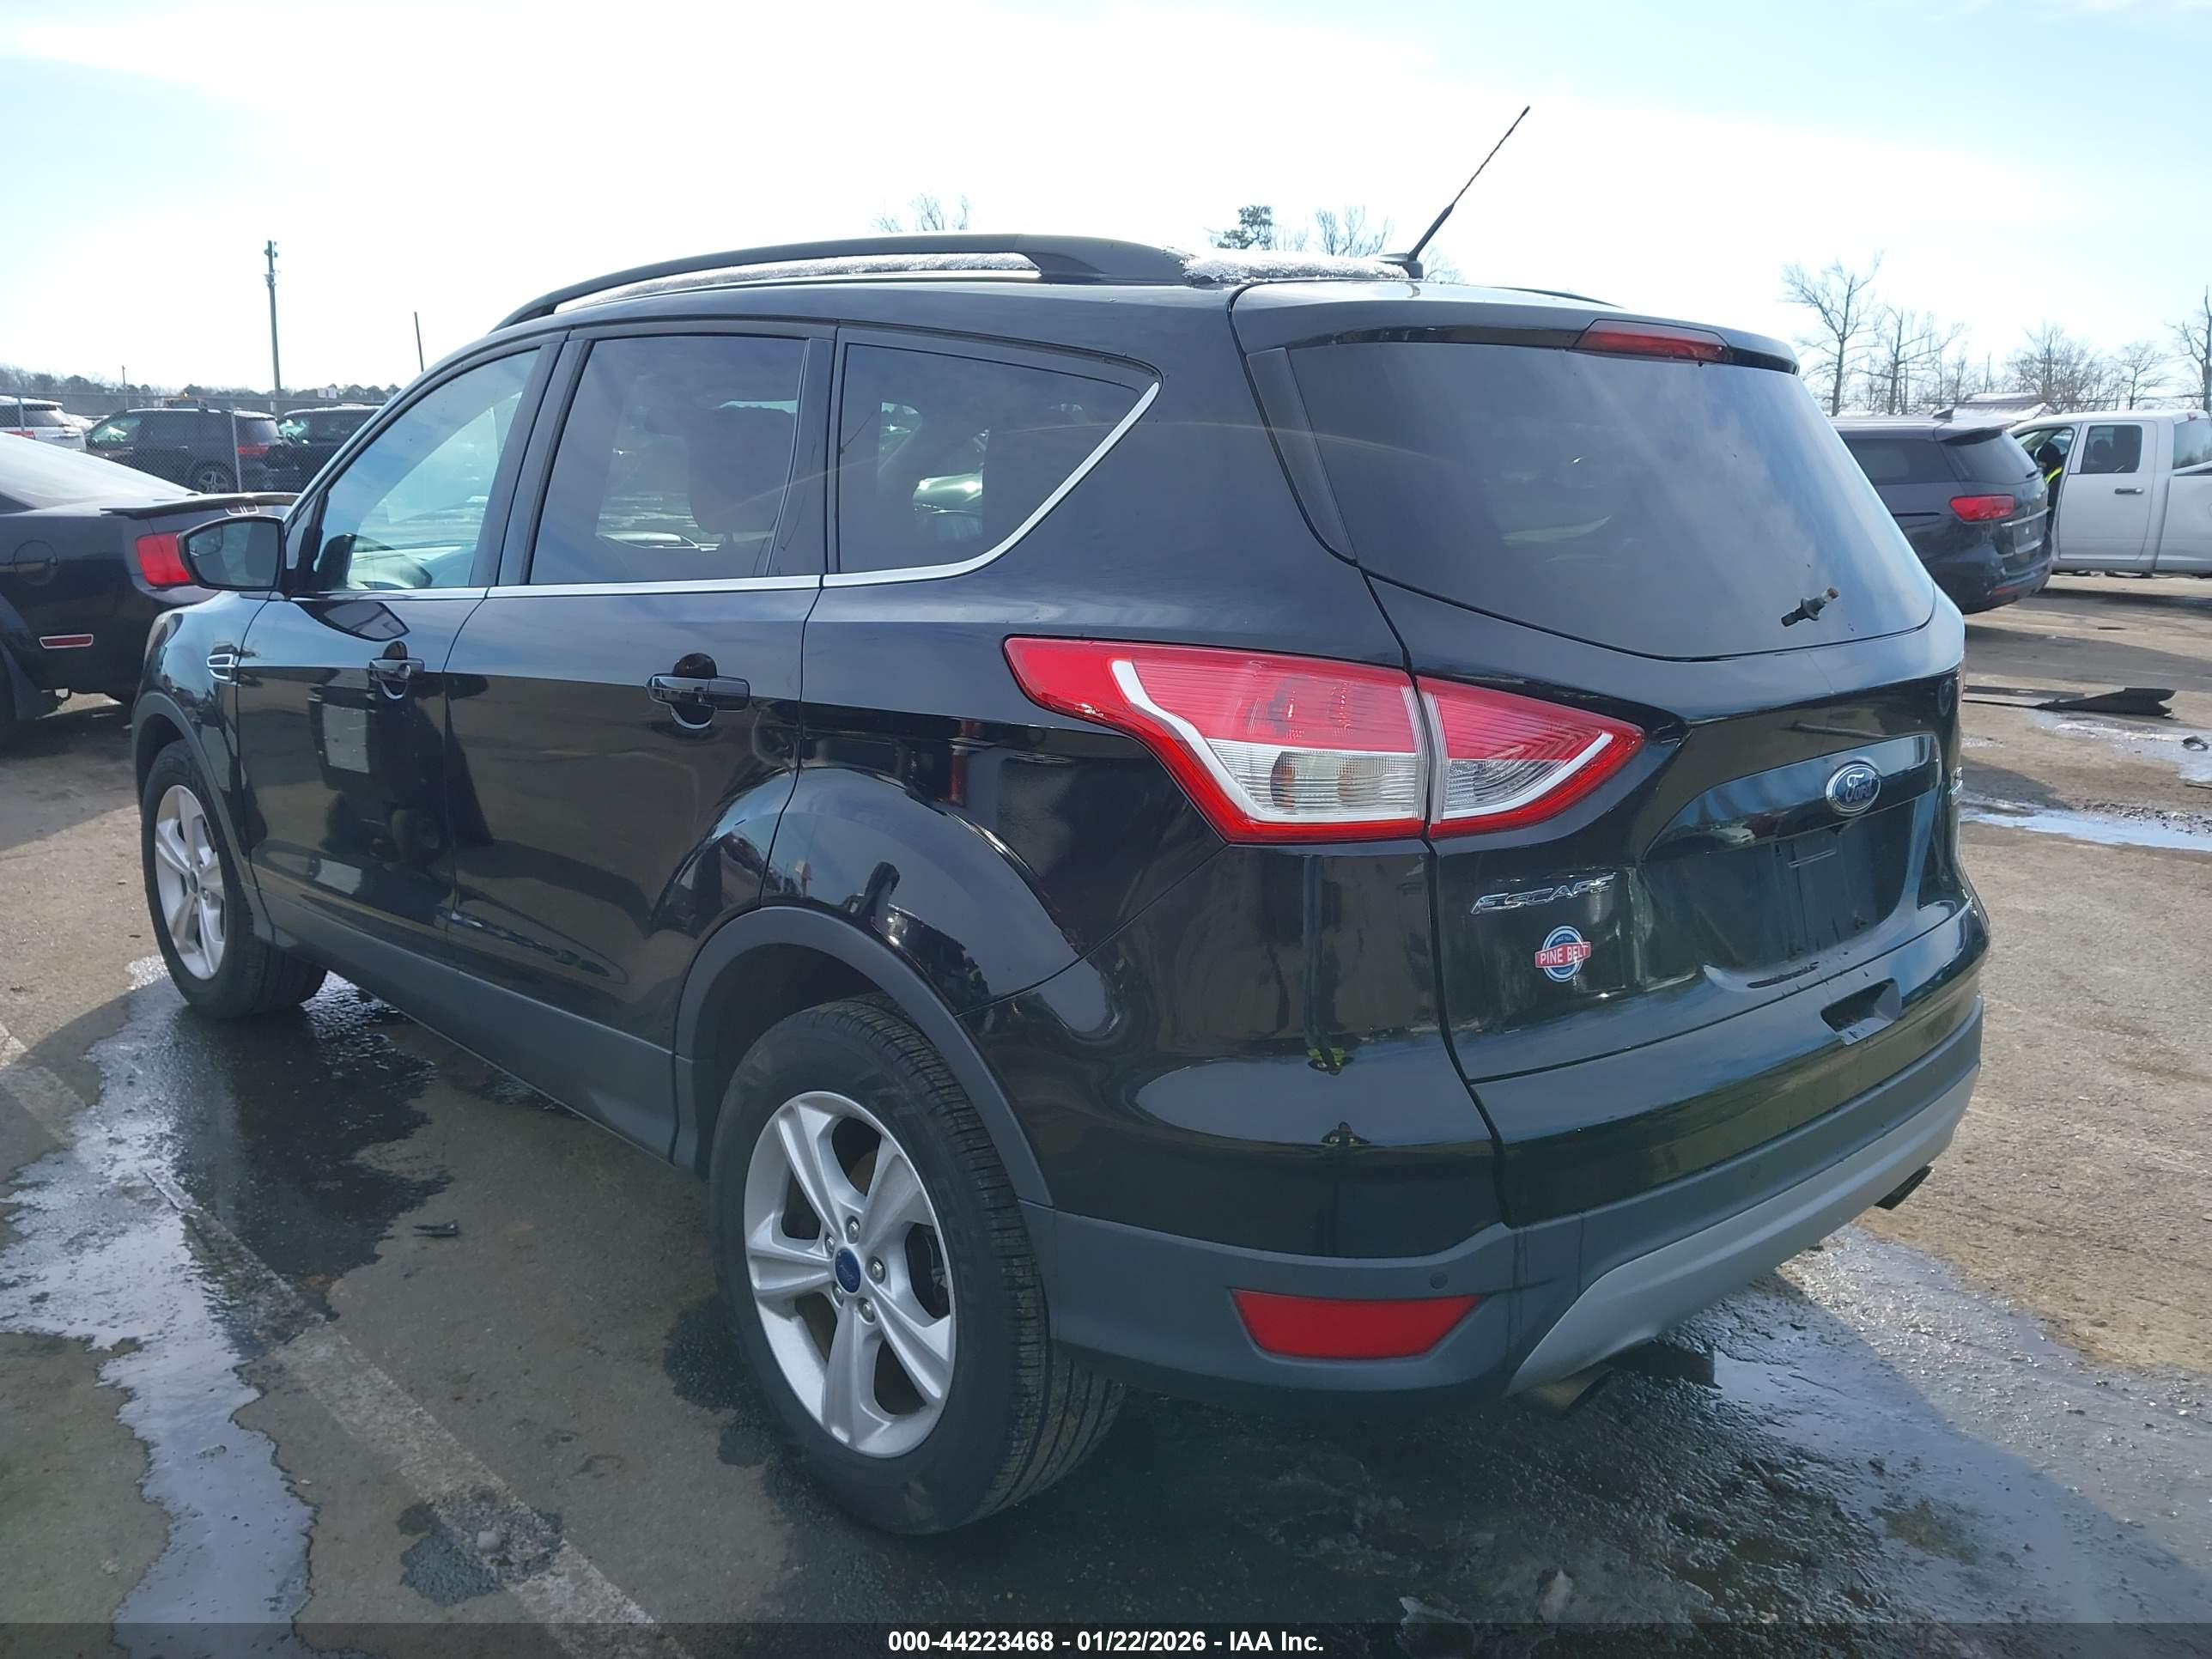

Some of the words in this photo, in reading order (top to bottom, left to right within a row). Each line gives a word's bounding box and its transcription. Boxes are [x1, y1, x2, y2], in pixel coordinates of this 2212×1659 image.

[1845, 772, 1873, 803] Ford
[1470, 873, 1616, 915] ESCAPE
[1540, 947, 1564, 964] PINE
[1566, 945, 1589, 963] BELT
